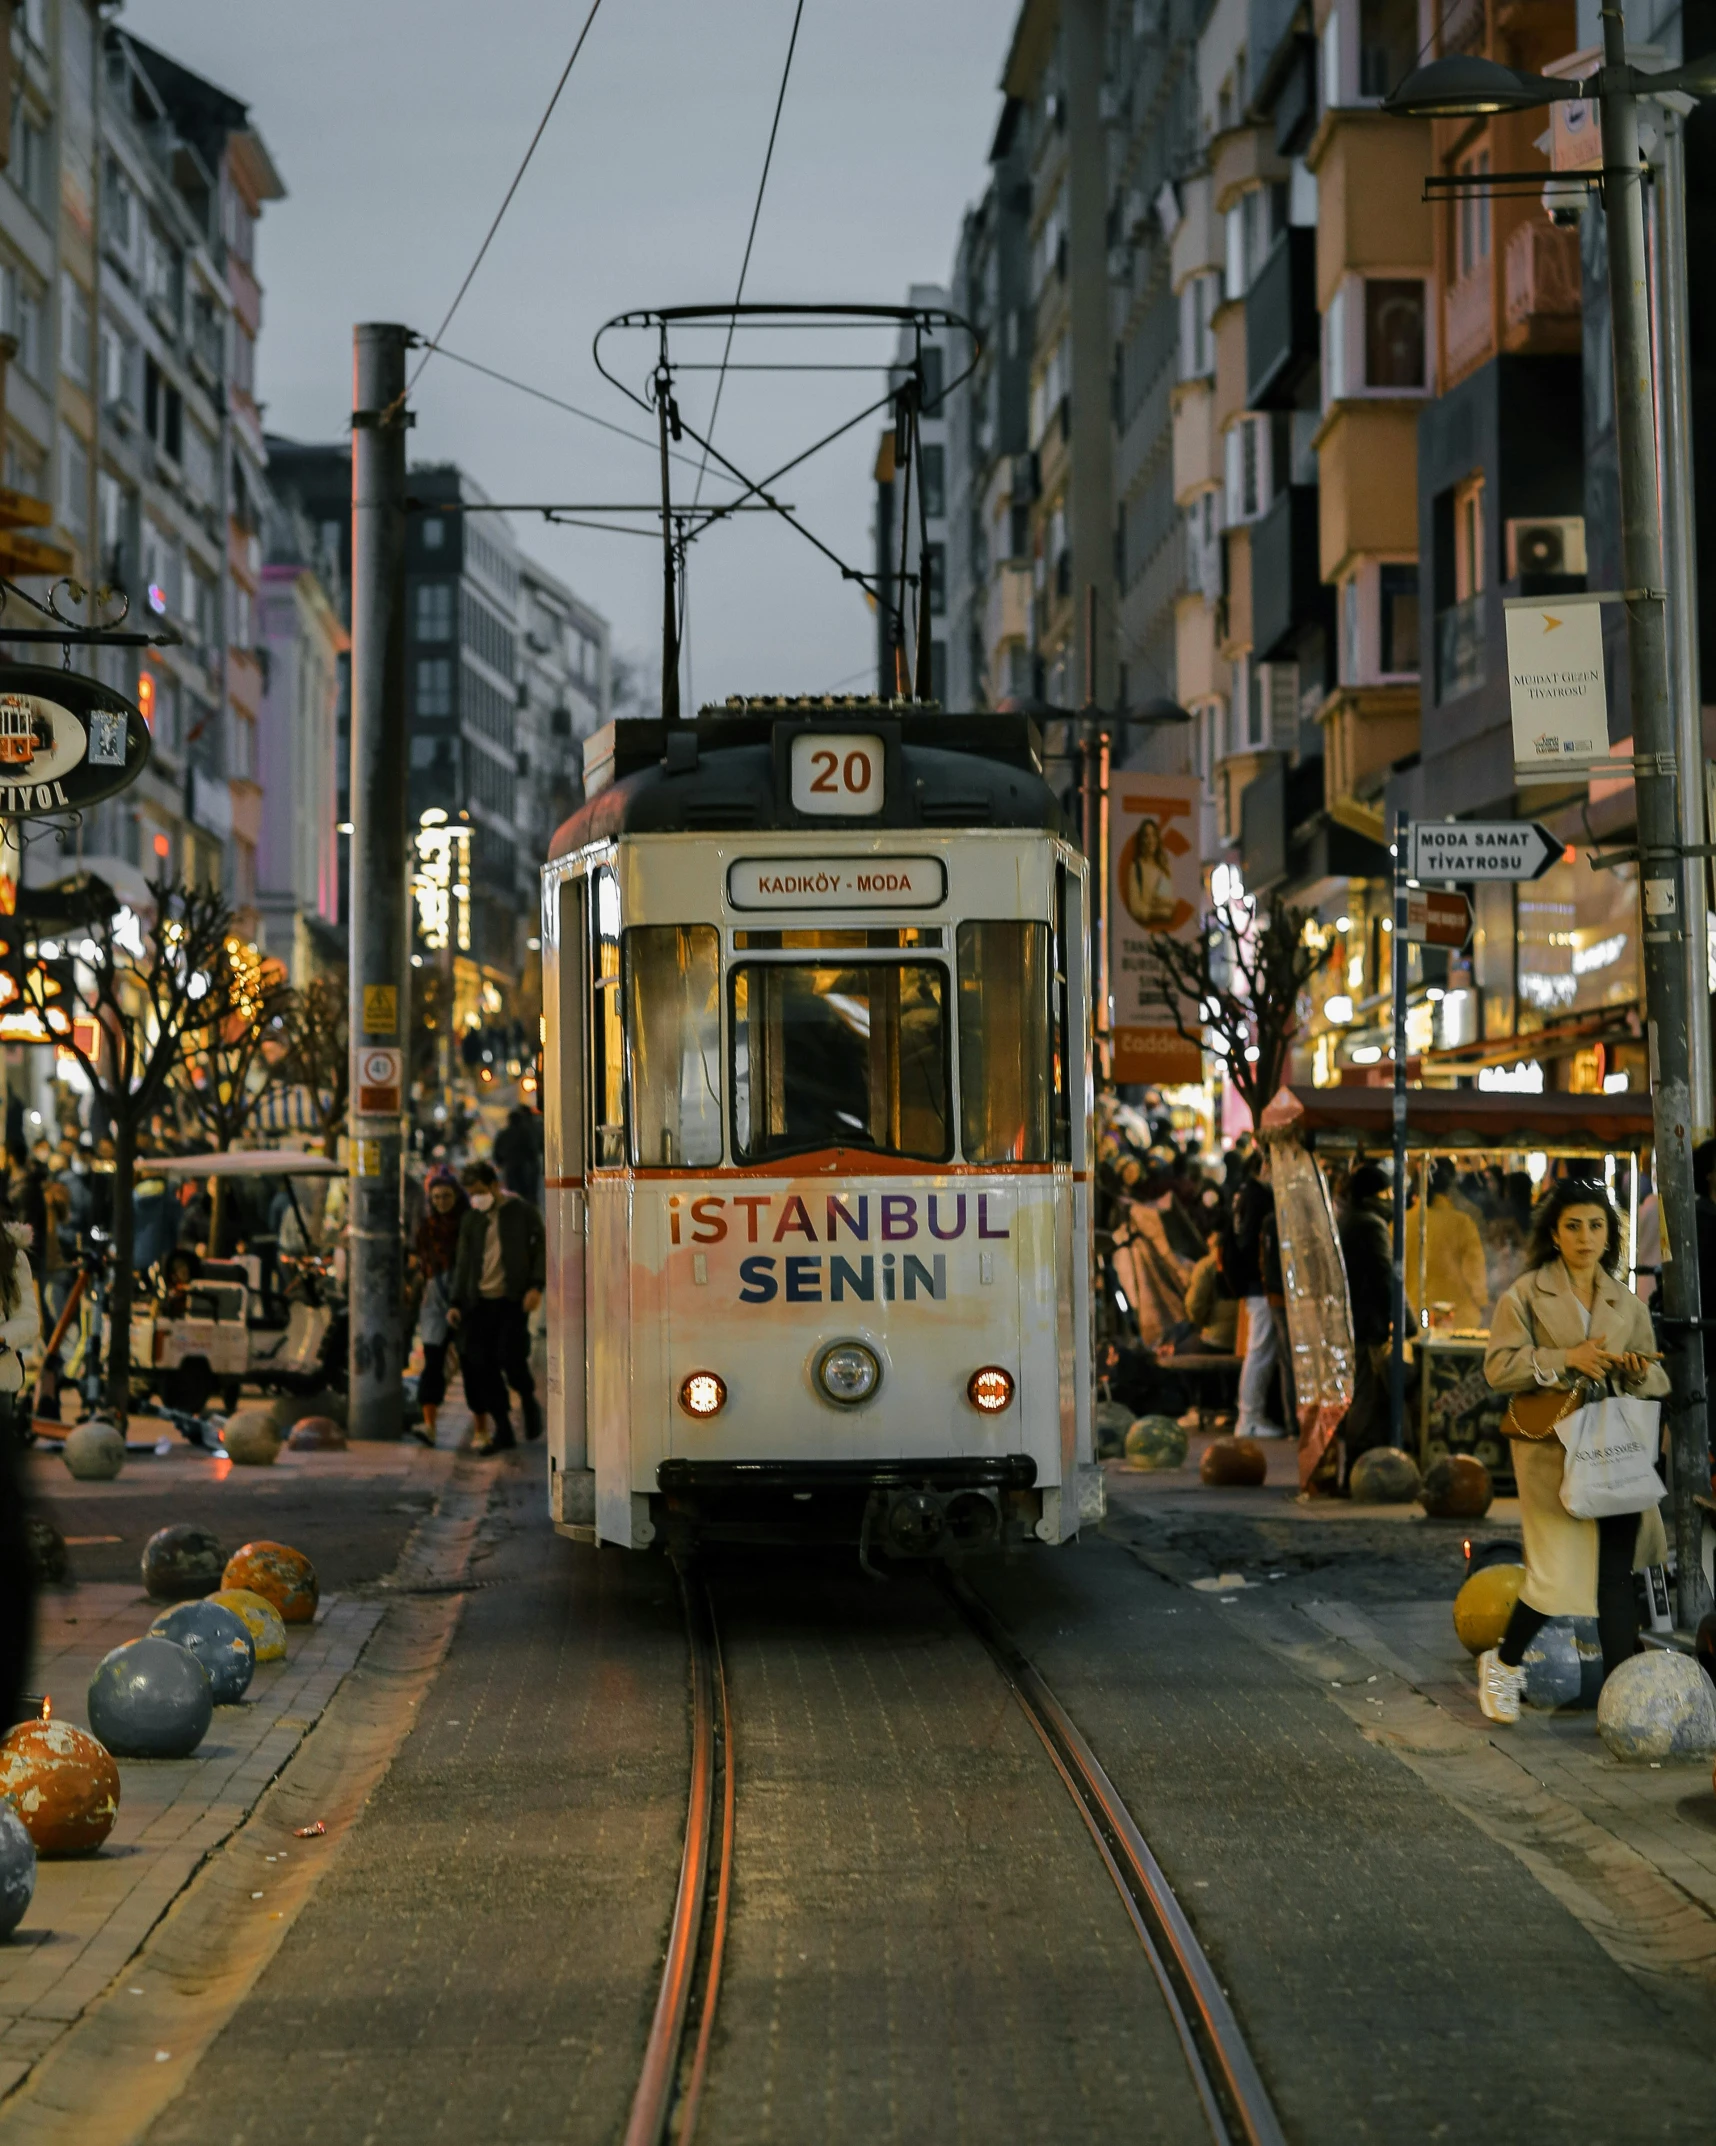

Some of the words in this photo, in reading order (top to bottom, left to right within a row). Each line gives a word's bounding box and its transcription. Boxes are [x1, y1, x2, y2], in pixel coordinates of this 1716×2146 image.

[810, 750, 871, 793] 20
[1421, 833, 1468, 847] MODA
[1475, 832, 1530, 847] SANAT
[1428, 852, 1522, 870] TİYATROSU
[758, 872, 841, 894] KADIKÖY
[857, 874, 912, 892] MODA
